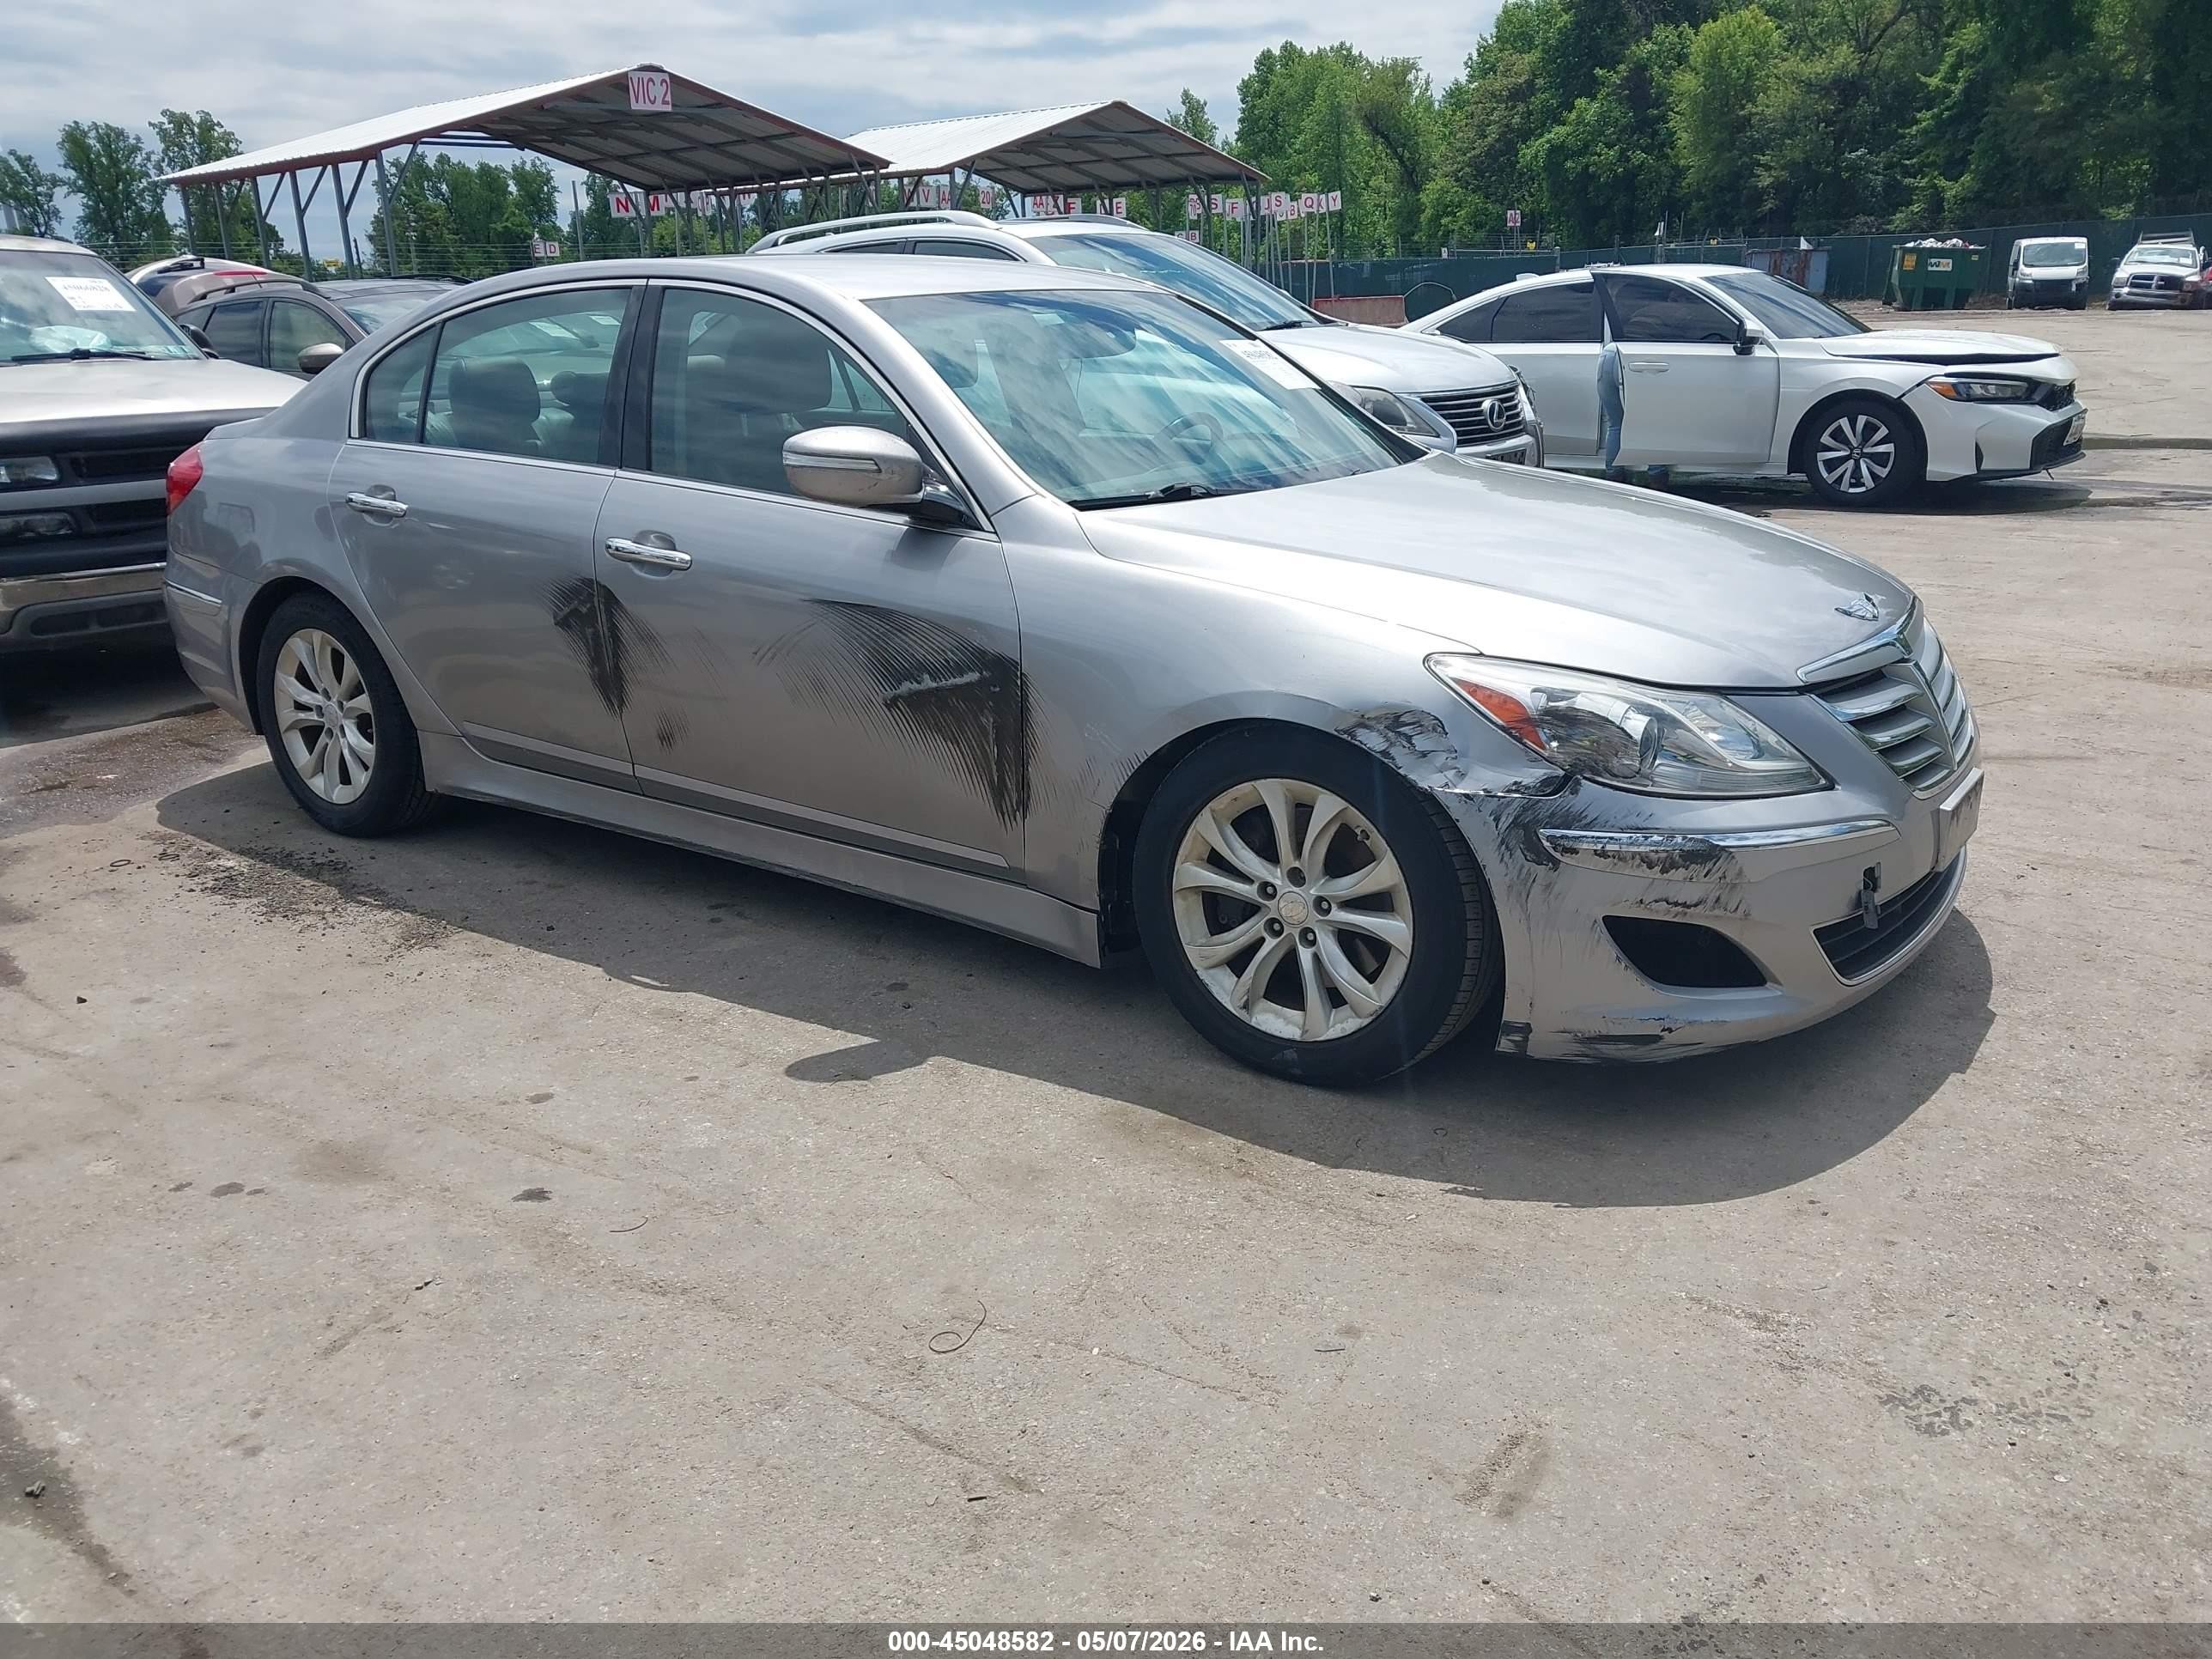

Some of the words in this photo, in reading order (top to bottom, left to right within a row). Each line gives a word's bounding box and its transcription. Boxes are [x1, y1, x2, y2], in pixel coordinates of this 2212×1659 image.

[629, 76, 657, 105] VIC
[659, 78, 671, 106] 2
[981, 190, 991, 205] 20
[1032, 195, 1045, 209] AA
[1210, 198, 1218, 210] S
[1274, 195, 1282, 208] S
[1304, 197, 1314, 210] Q
[1331, 195, 1338, 207] Y
[615, 197, 630, 214] N
[1115, 201, 1123, 215] E
[533, 243, 542, 254] E
[550, 244, 556, 254] D
